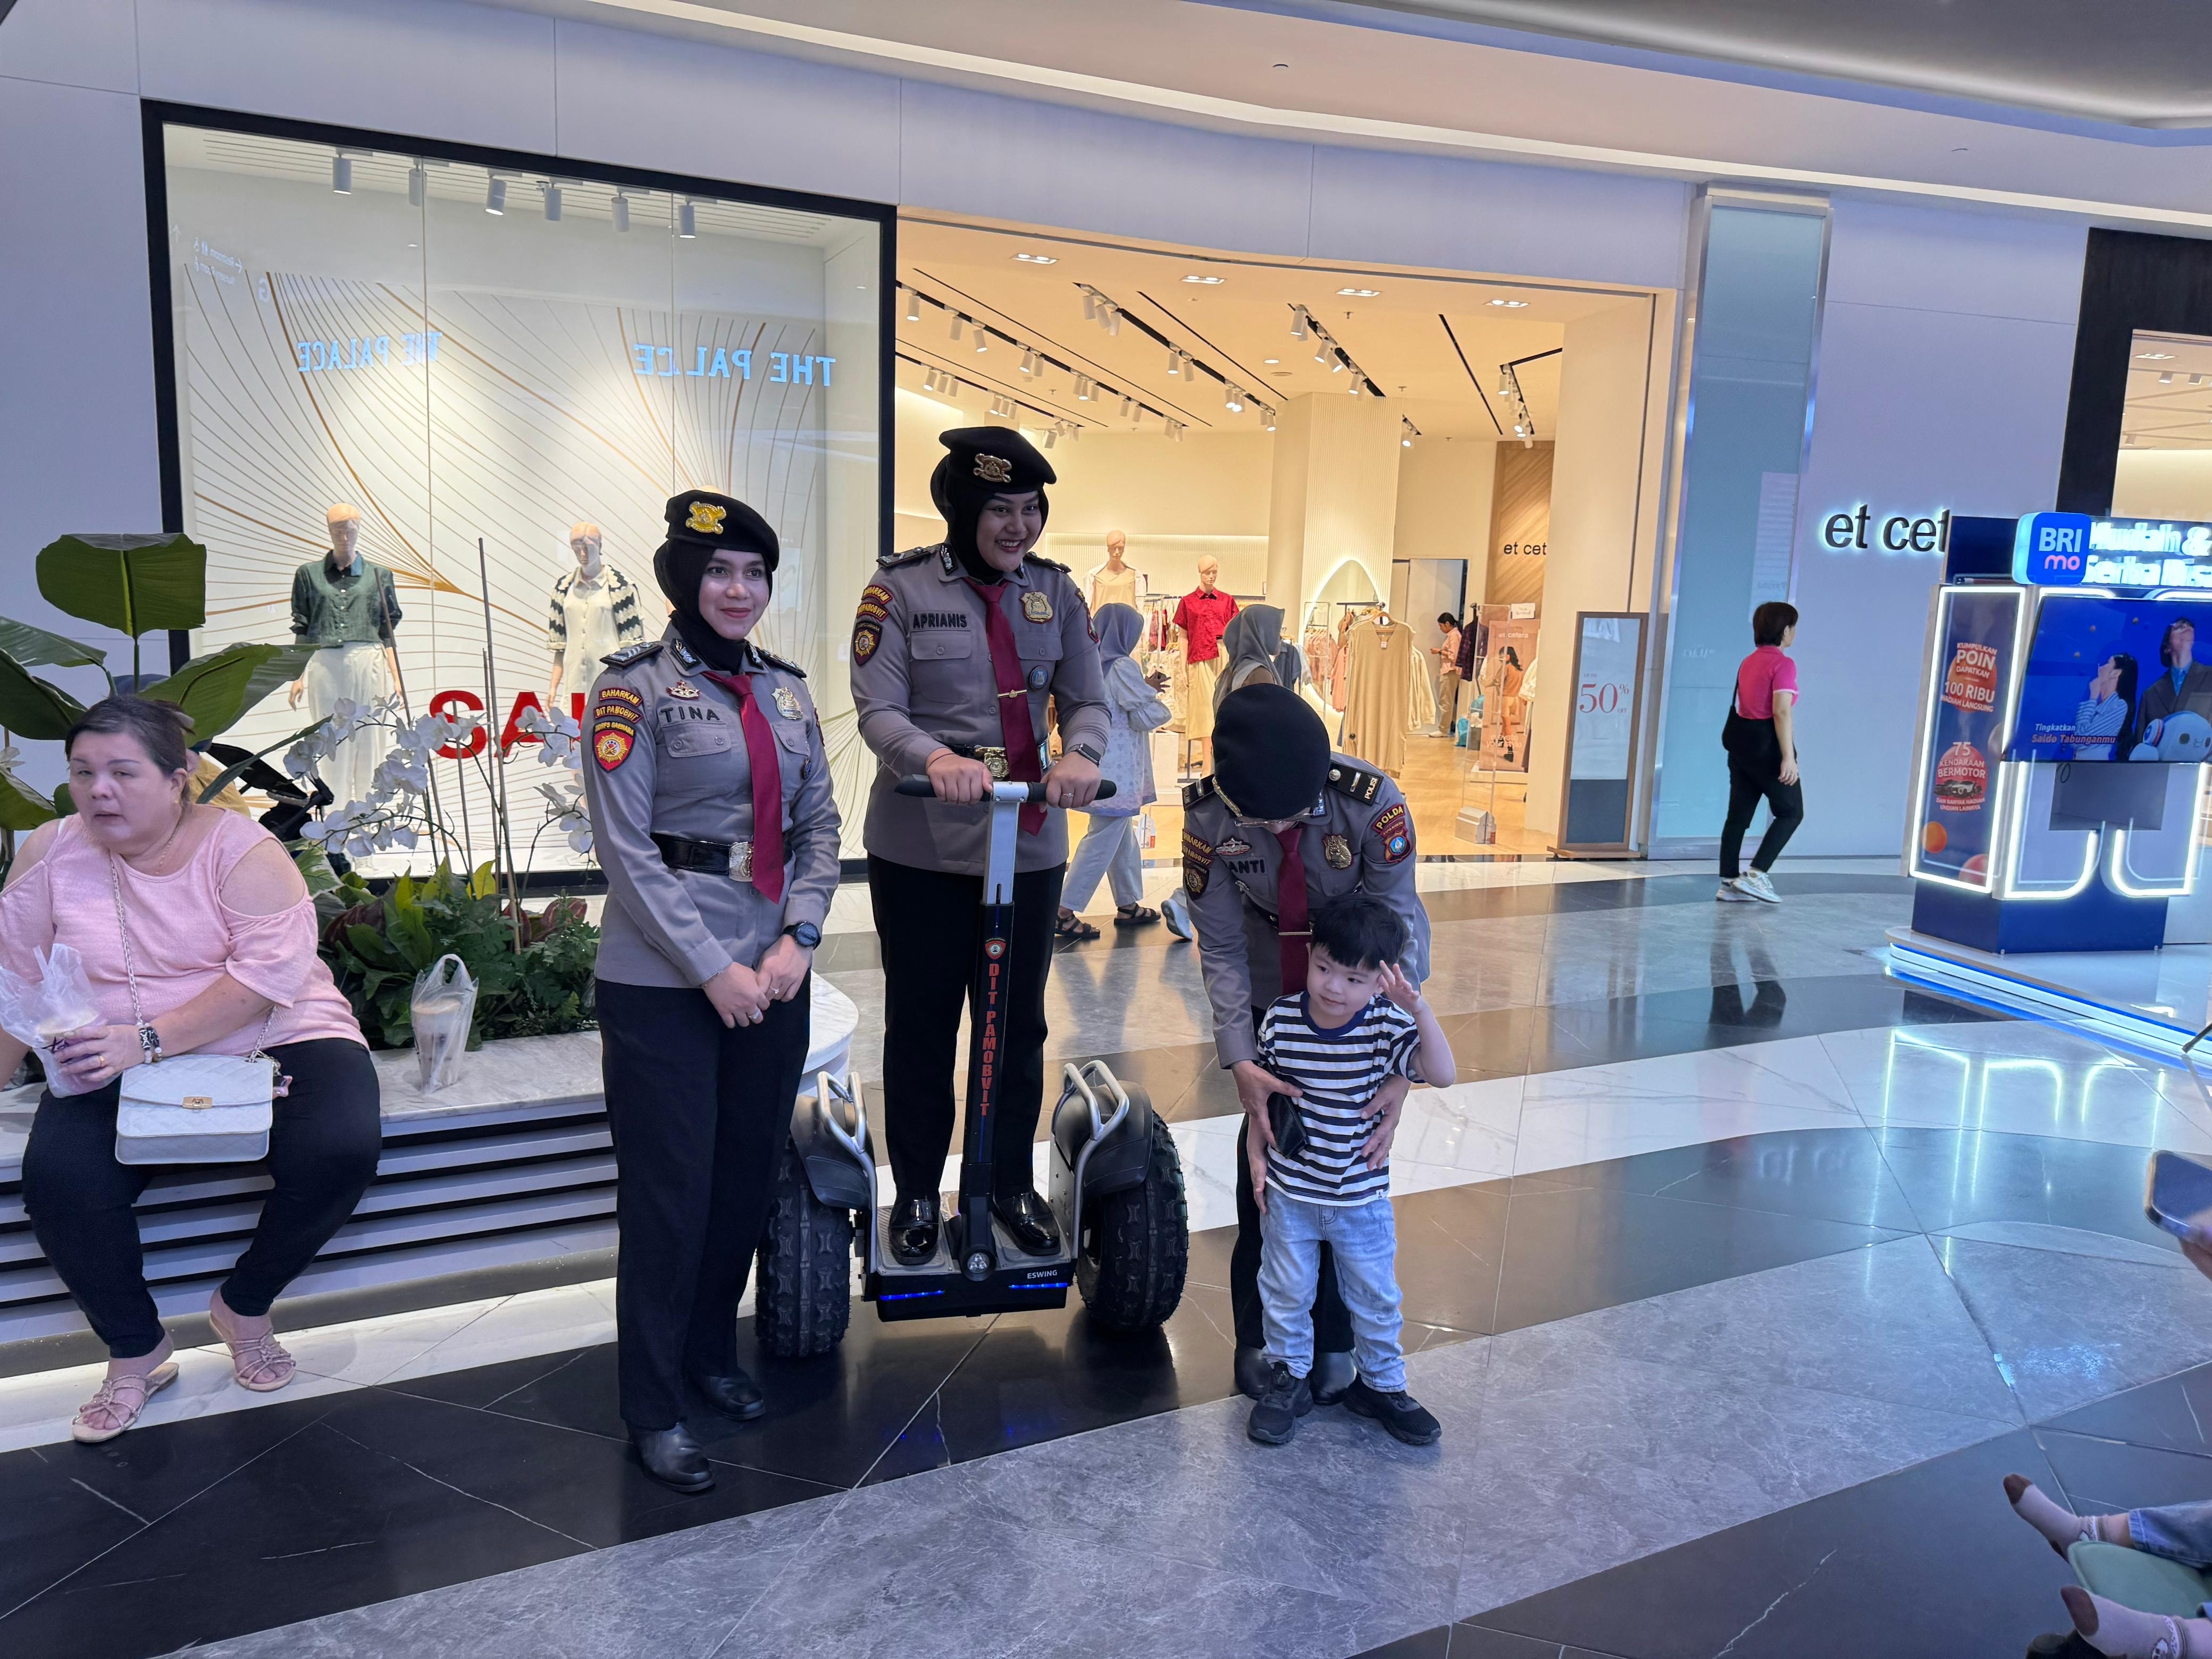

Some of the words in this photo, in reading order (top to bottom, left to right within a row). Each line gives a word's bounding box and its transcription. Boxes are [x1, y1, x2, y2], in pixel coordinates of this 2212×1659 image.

[1825, 504, 1871, 548] et
[2039, 527, 2083, 552] BRI
[1504, 542, 1518, 555] et
[1523, 542, 1547, 555] cet
[2045, 555, 2080, 571] mo
[913, 613, 967, 629] APRIANIS
[1957, 642, 1997, 656] KUMPULKAN
[1956, 649, 1996, 671] POIN
[1956, 666, 1990, 679] DAPATKAN
[1945, 681, 1964, 696] 100
[1966, 684, 1995, 703] RIBU
[596, 707, 606, 716] DIT
[1962, 700, 1993, 712] LANGSUNG
[660, 706, 720, 723] TINA
[2035, 724, 2076, 732] Tingkatkan
[2032, 733, 2057, 743] Saldo
[2059, 734, 2116, 744] Tabunganmu
[1953, 742, 1971, 756] 75
[1939, 759, 1984, 767] KENDARAAN
[1938, 767, 1985, 778] BERMOTOR
[1364, 777, 1378, 799] POLISI
[1376, 806, 1404, 830] POLDA
[988, 963, 1000, 1004] DIT
[980, 1011, 996, 1116] PAMOBVIT
[1027, 1270, 1058, 1279] ESWING
